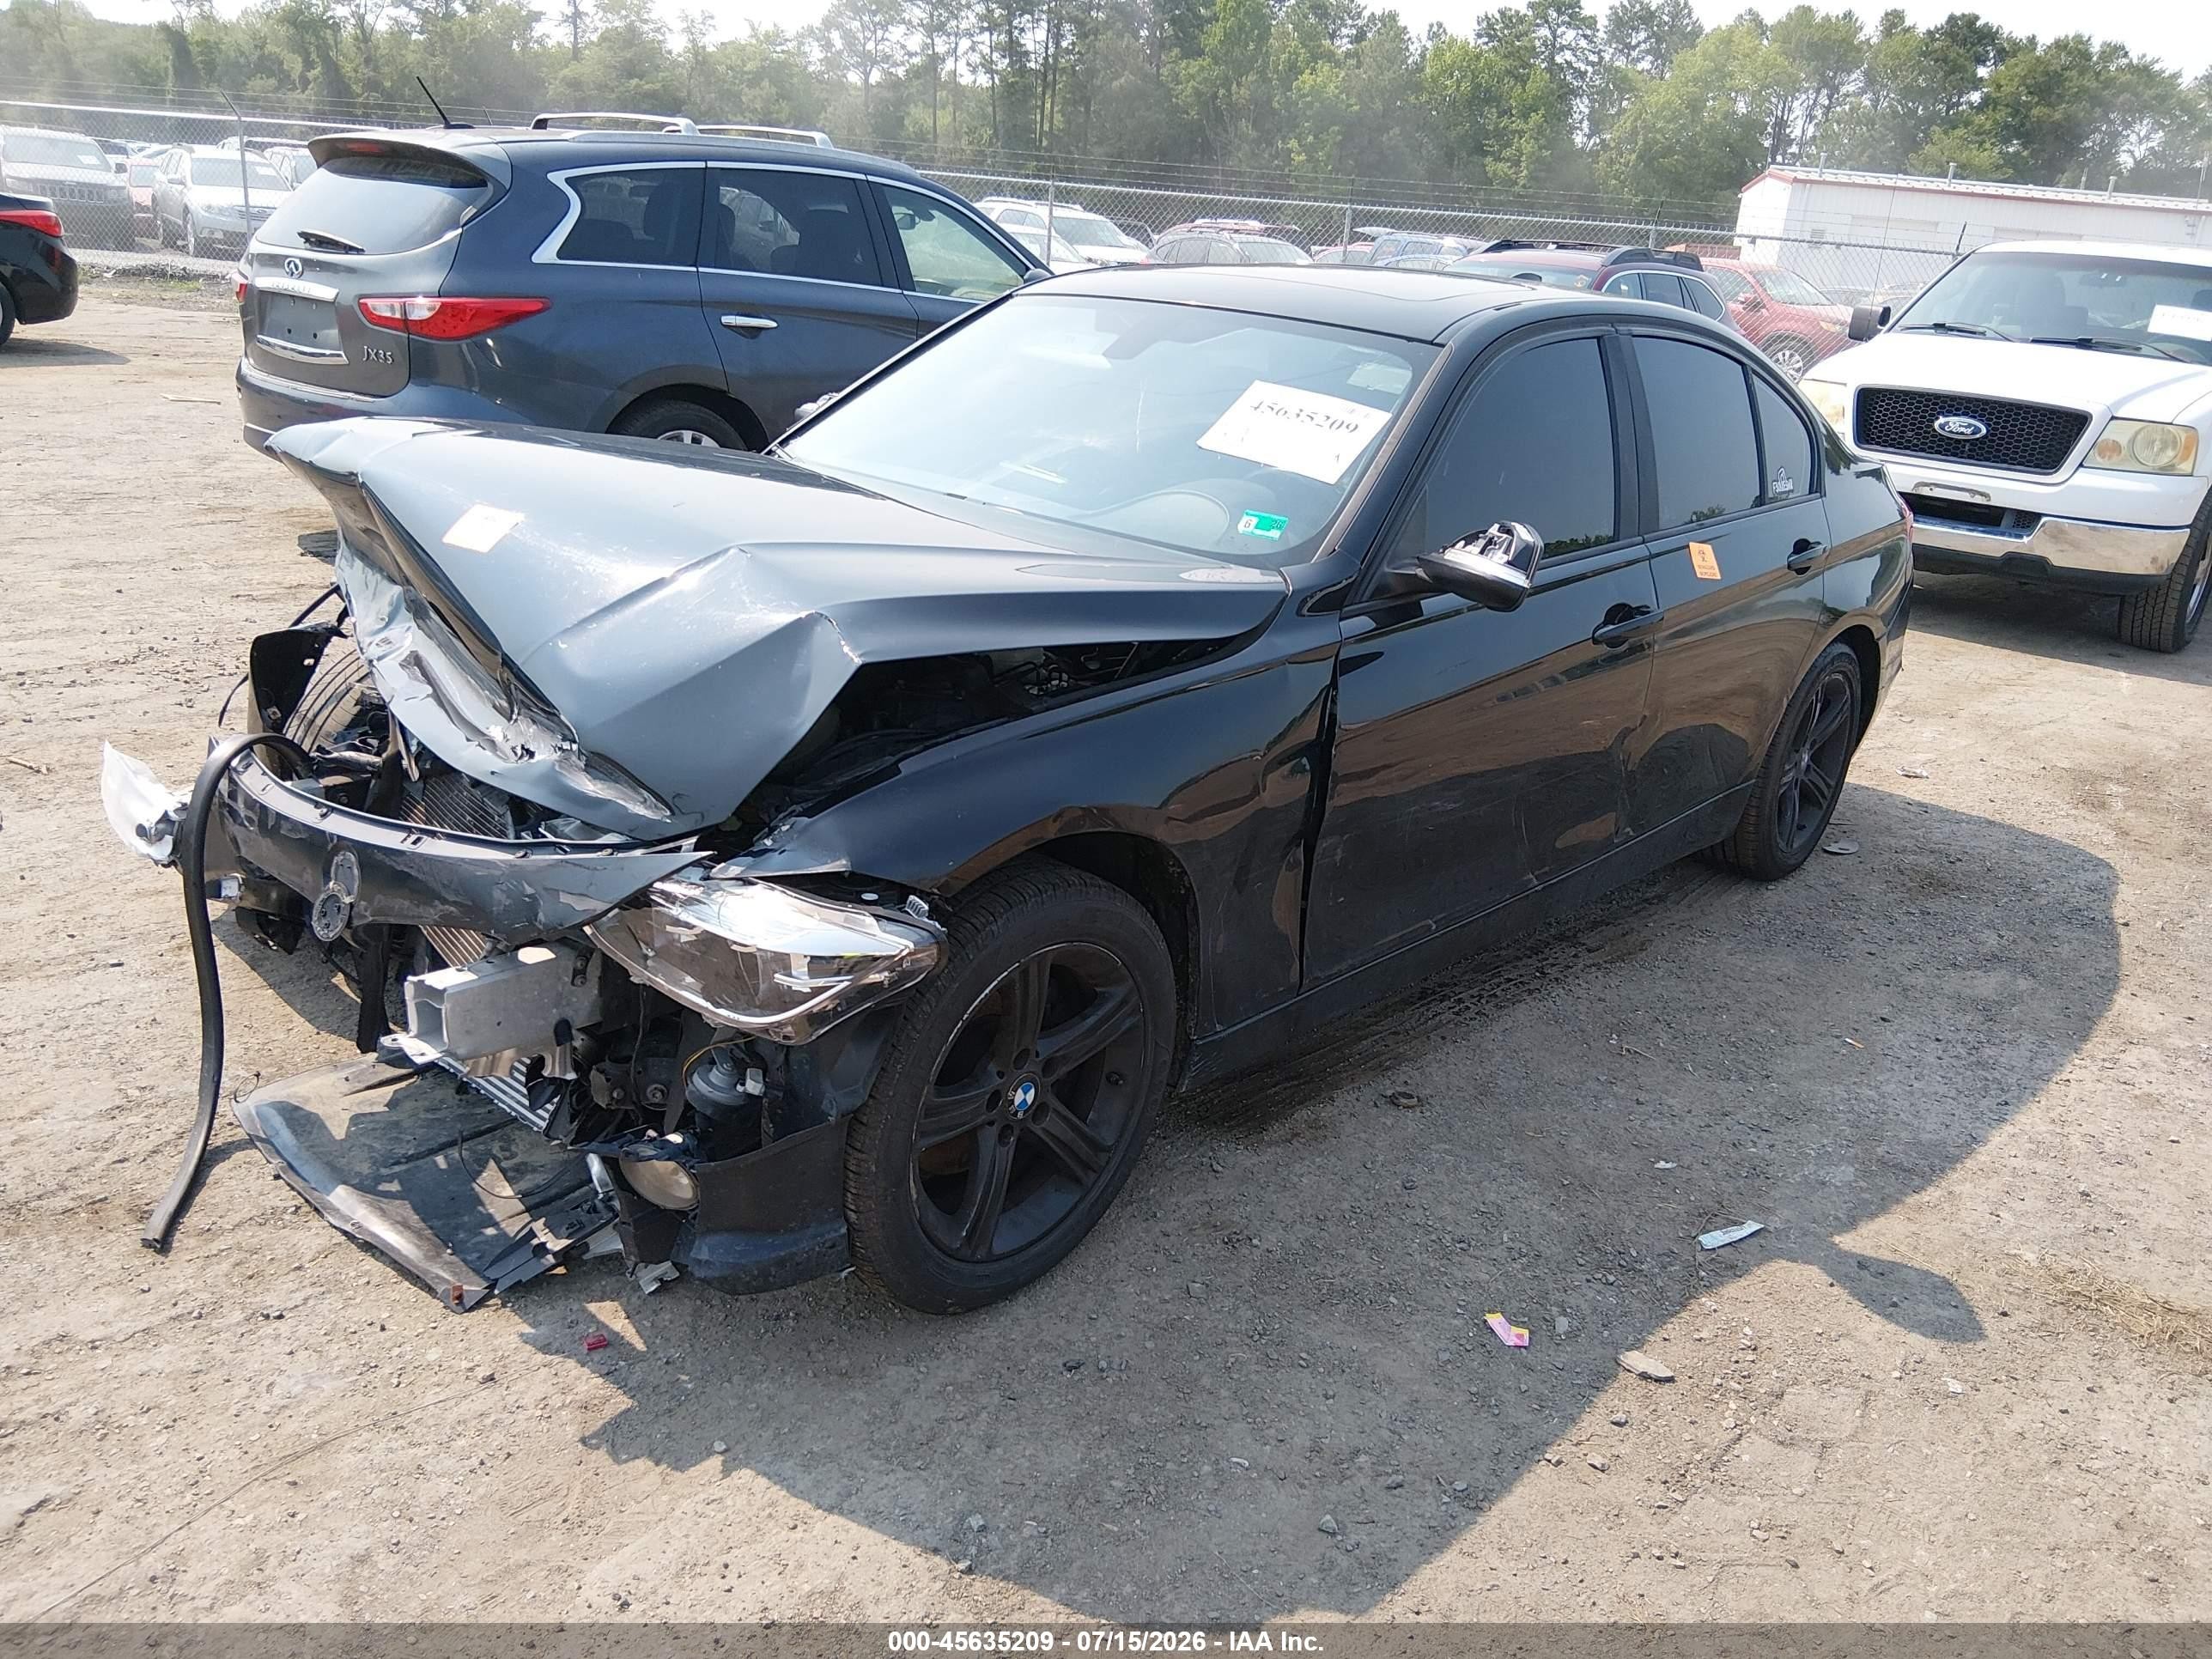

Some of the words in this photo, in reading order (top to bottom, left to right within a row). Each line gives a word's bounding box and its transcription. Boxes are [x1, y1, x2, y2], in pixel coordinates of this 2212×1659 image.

[362, 345, 394, 364] JX35
[1250, 400, 1358, 433] 45635209
[1945, 421, 1975, 434] Ford
